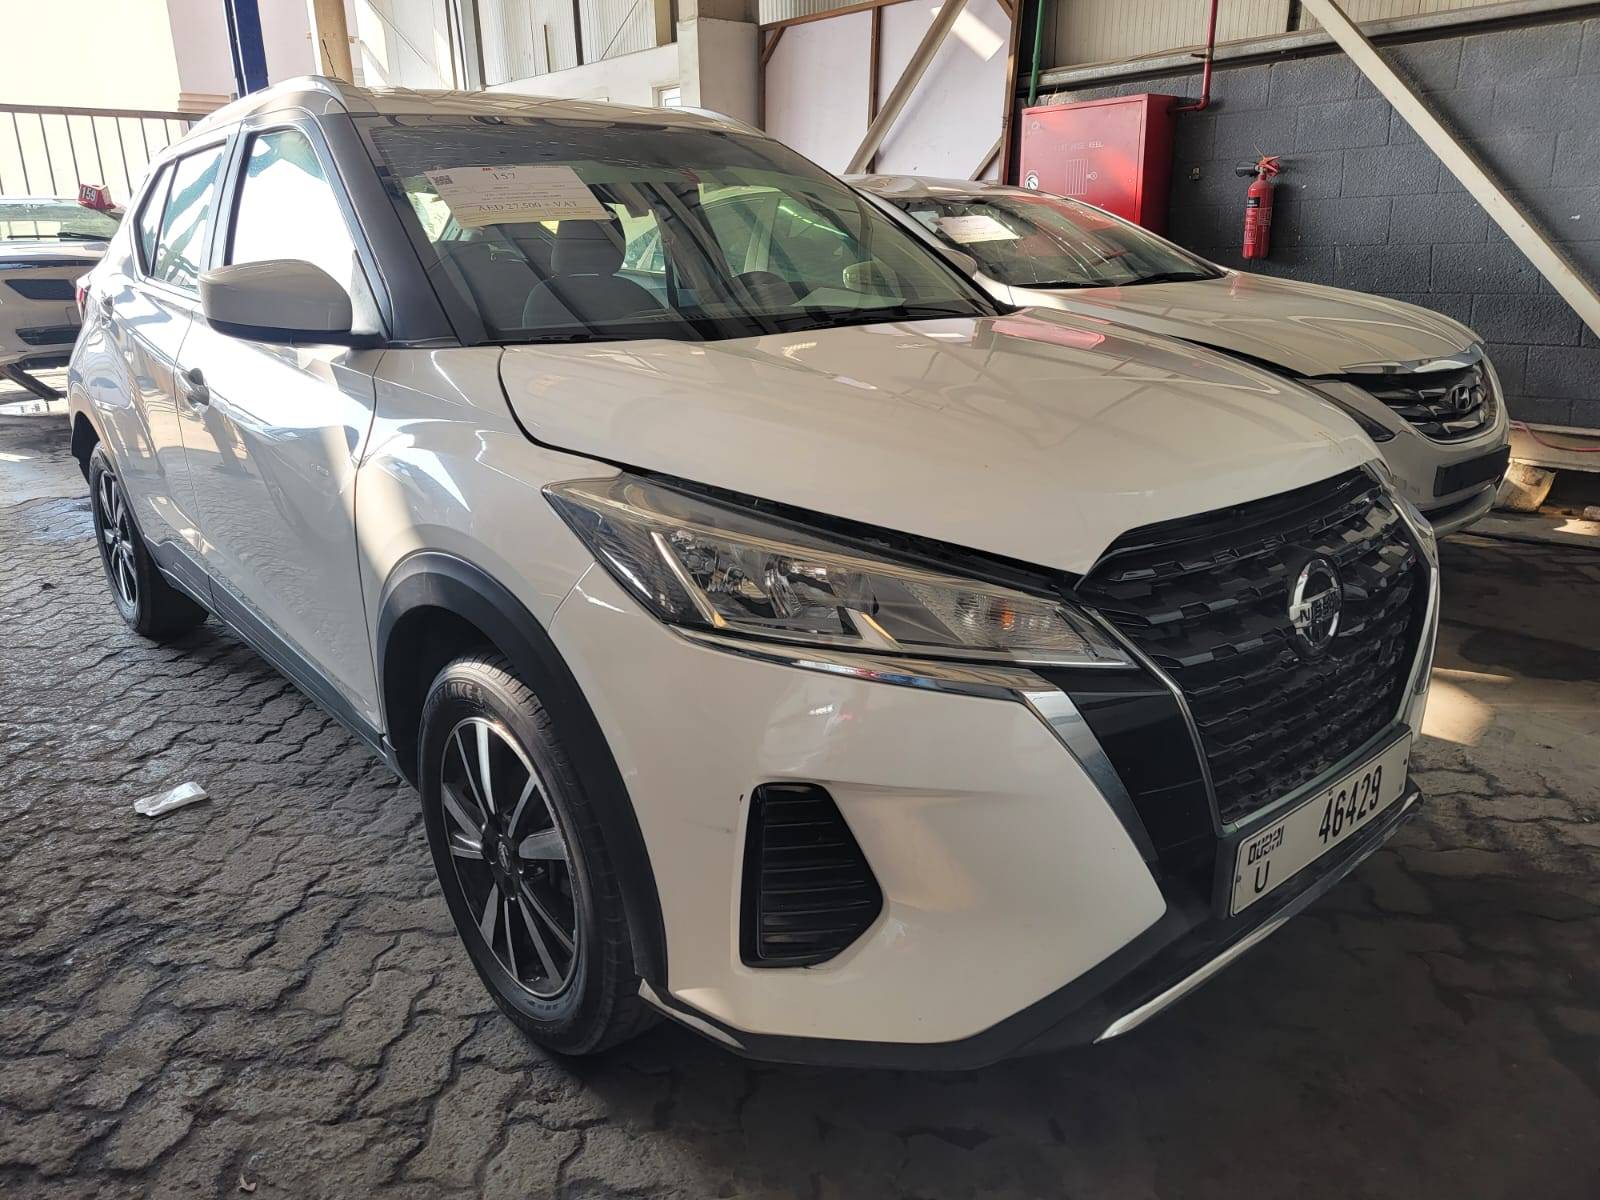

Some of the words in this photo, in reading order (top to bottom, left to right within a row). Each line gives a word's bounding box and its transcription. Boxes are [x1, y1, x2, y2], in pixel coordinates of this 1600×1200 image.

[492, 171, 516, 182] 157
[82, 187, 96, 201] 159
[1319, 765, 1383, 844] 46429
[1254, 861, 1270, 894] U
